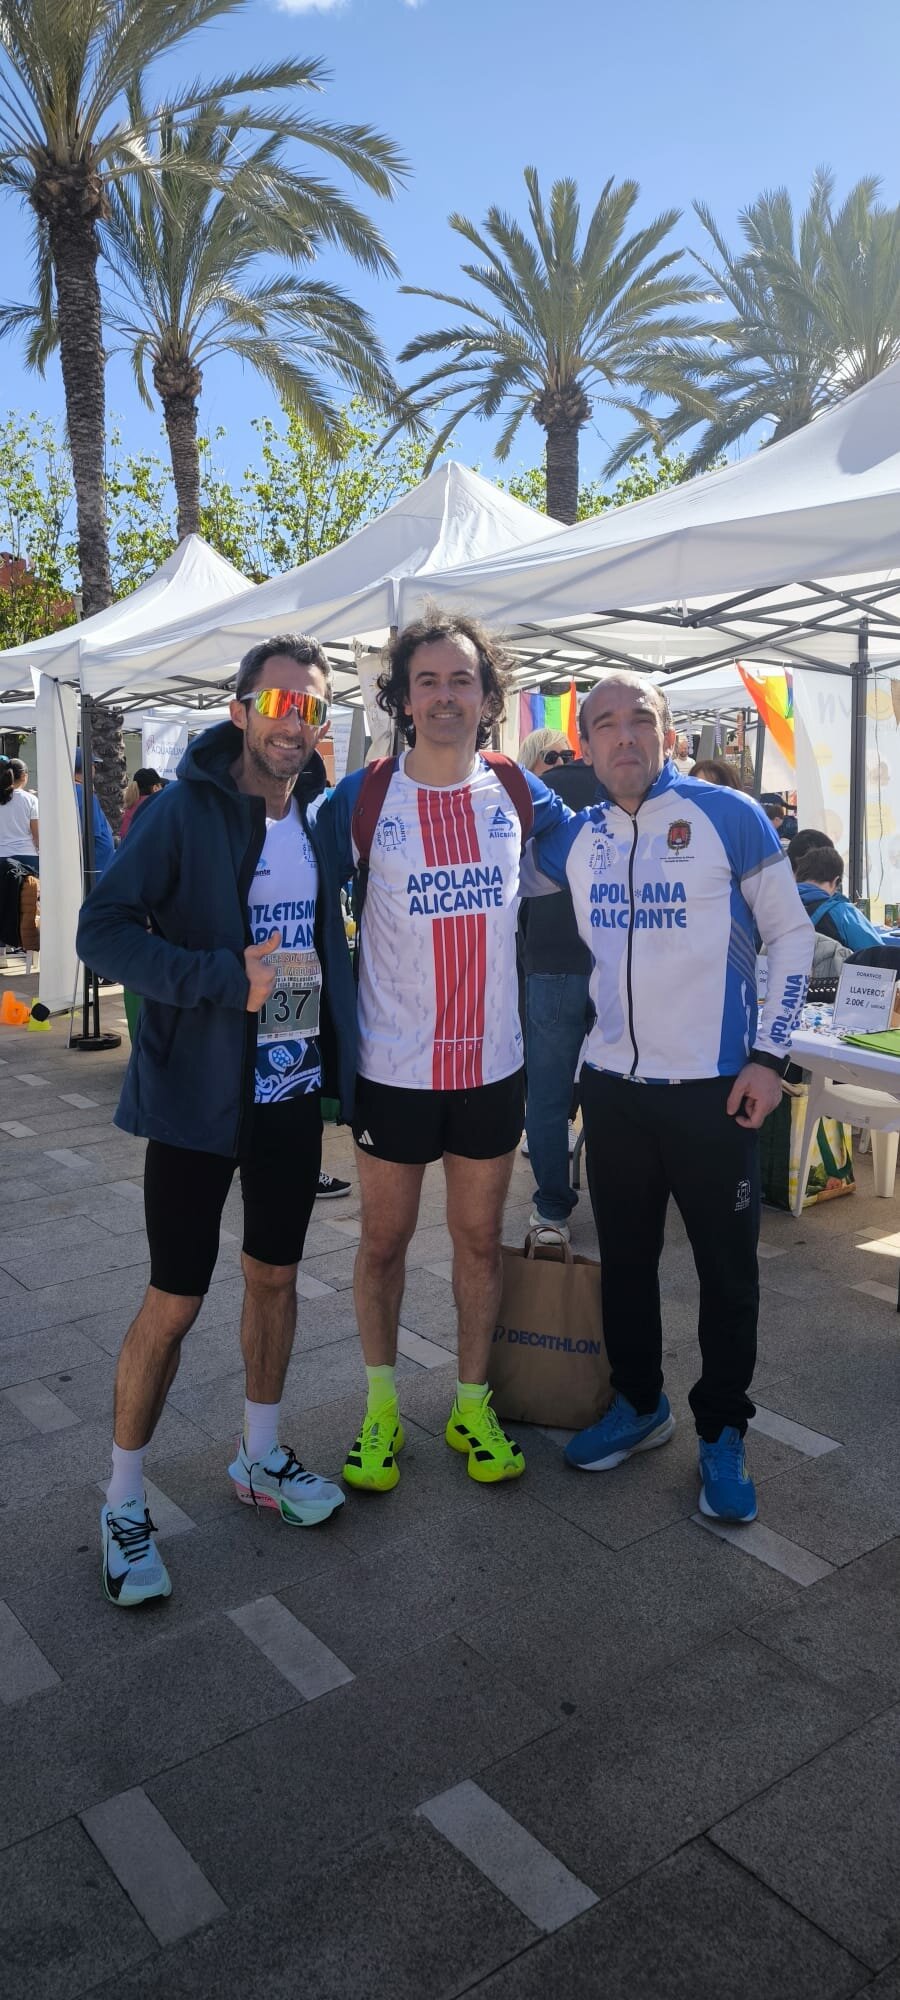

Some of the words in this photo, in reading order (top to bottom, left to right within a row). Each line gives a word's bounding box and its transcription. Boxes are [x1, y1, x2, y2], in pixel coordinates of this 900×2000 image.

[407, 865, 503, 894] APOLANA
[409, 887, 503, 916] ALICANTE
[590, 908, 688, 928] ALICANTE
[850, 986, 885, 997] LLAVEROS
[260, 989, 312, 1024] 137
[507, 1328, 601, 1354] DECATHLON
